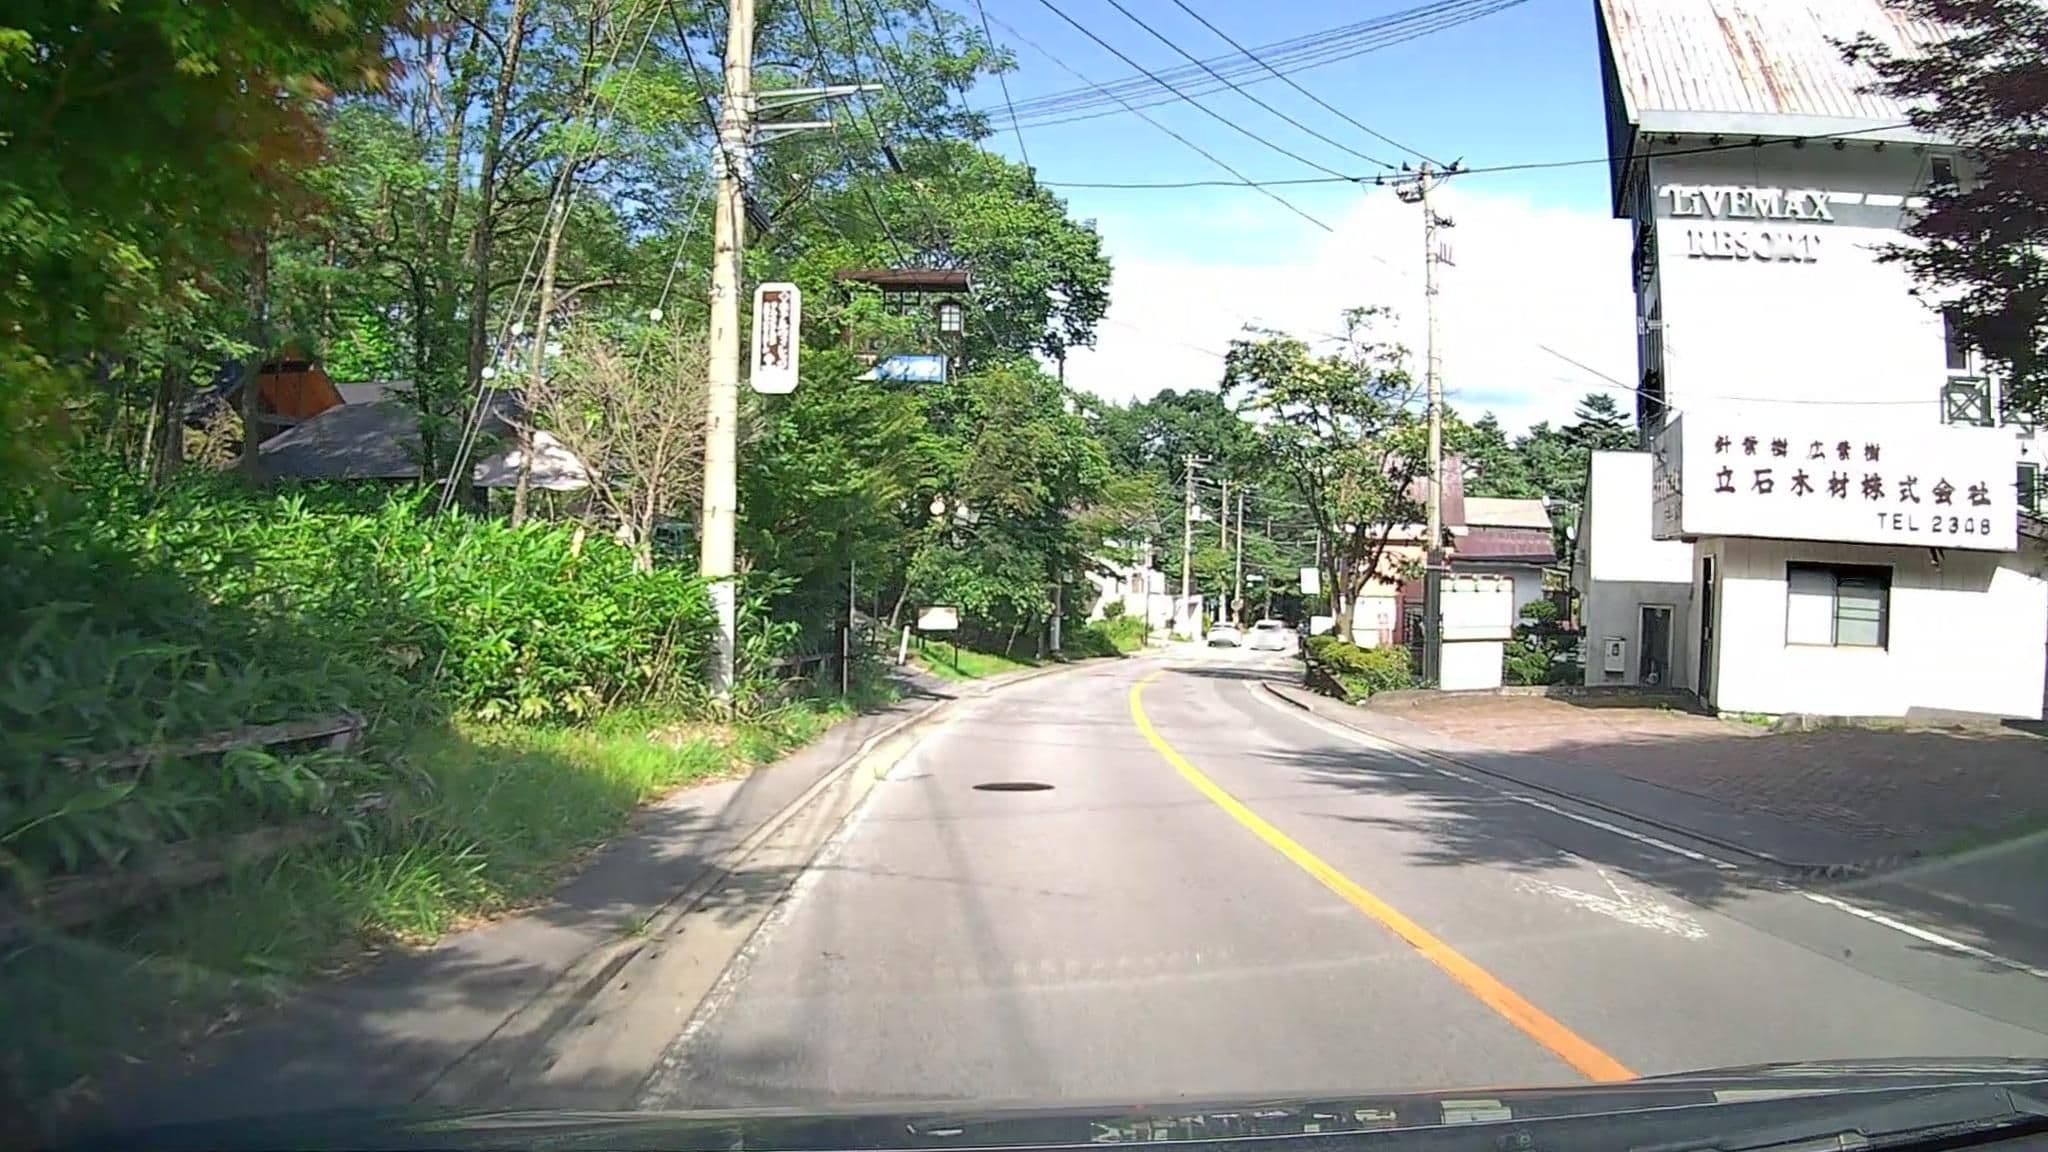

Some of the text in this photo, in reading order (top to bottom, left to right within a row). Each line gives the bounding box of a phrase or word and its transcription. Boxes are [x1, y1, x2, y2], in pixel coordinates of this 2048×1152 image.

[1687, 229, 1822, 264] RESORT
[1714, 465, 1992, 507] 立石木材株式会社
[1877, 512, 1919, 532] TEL
